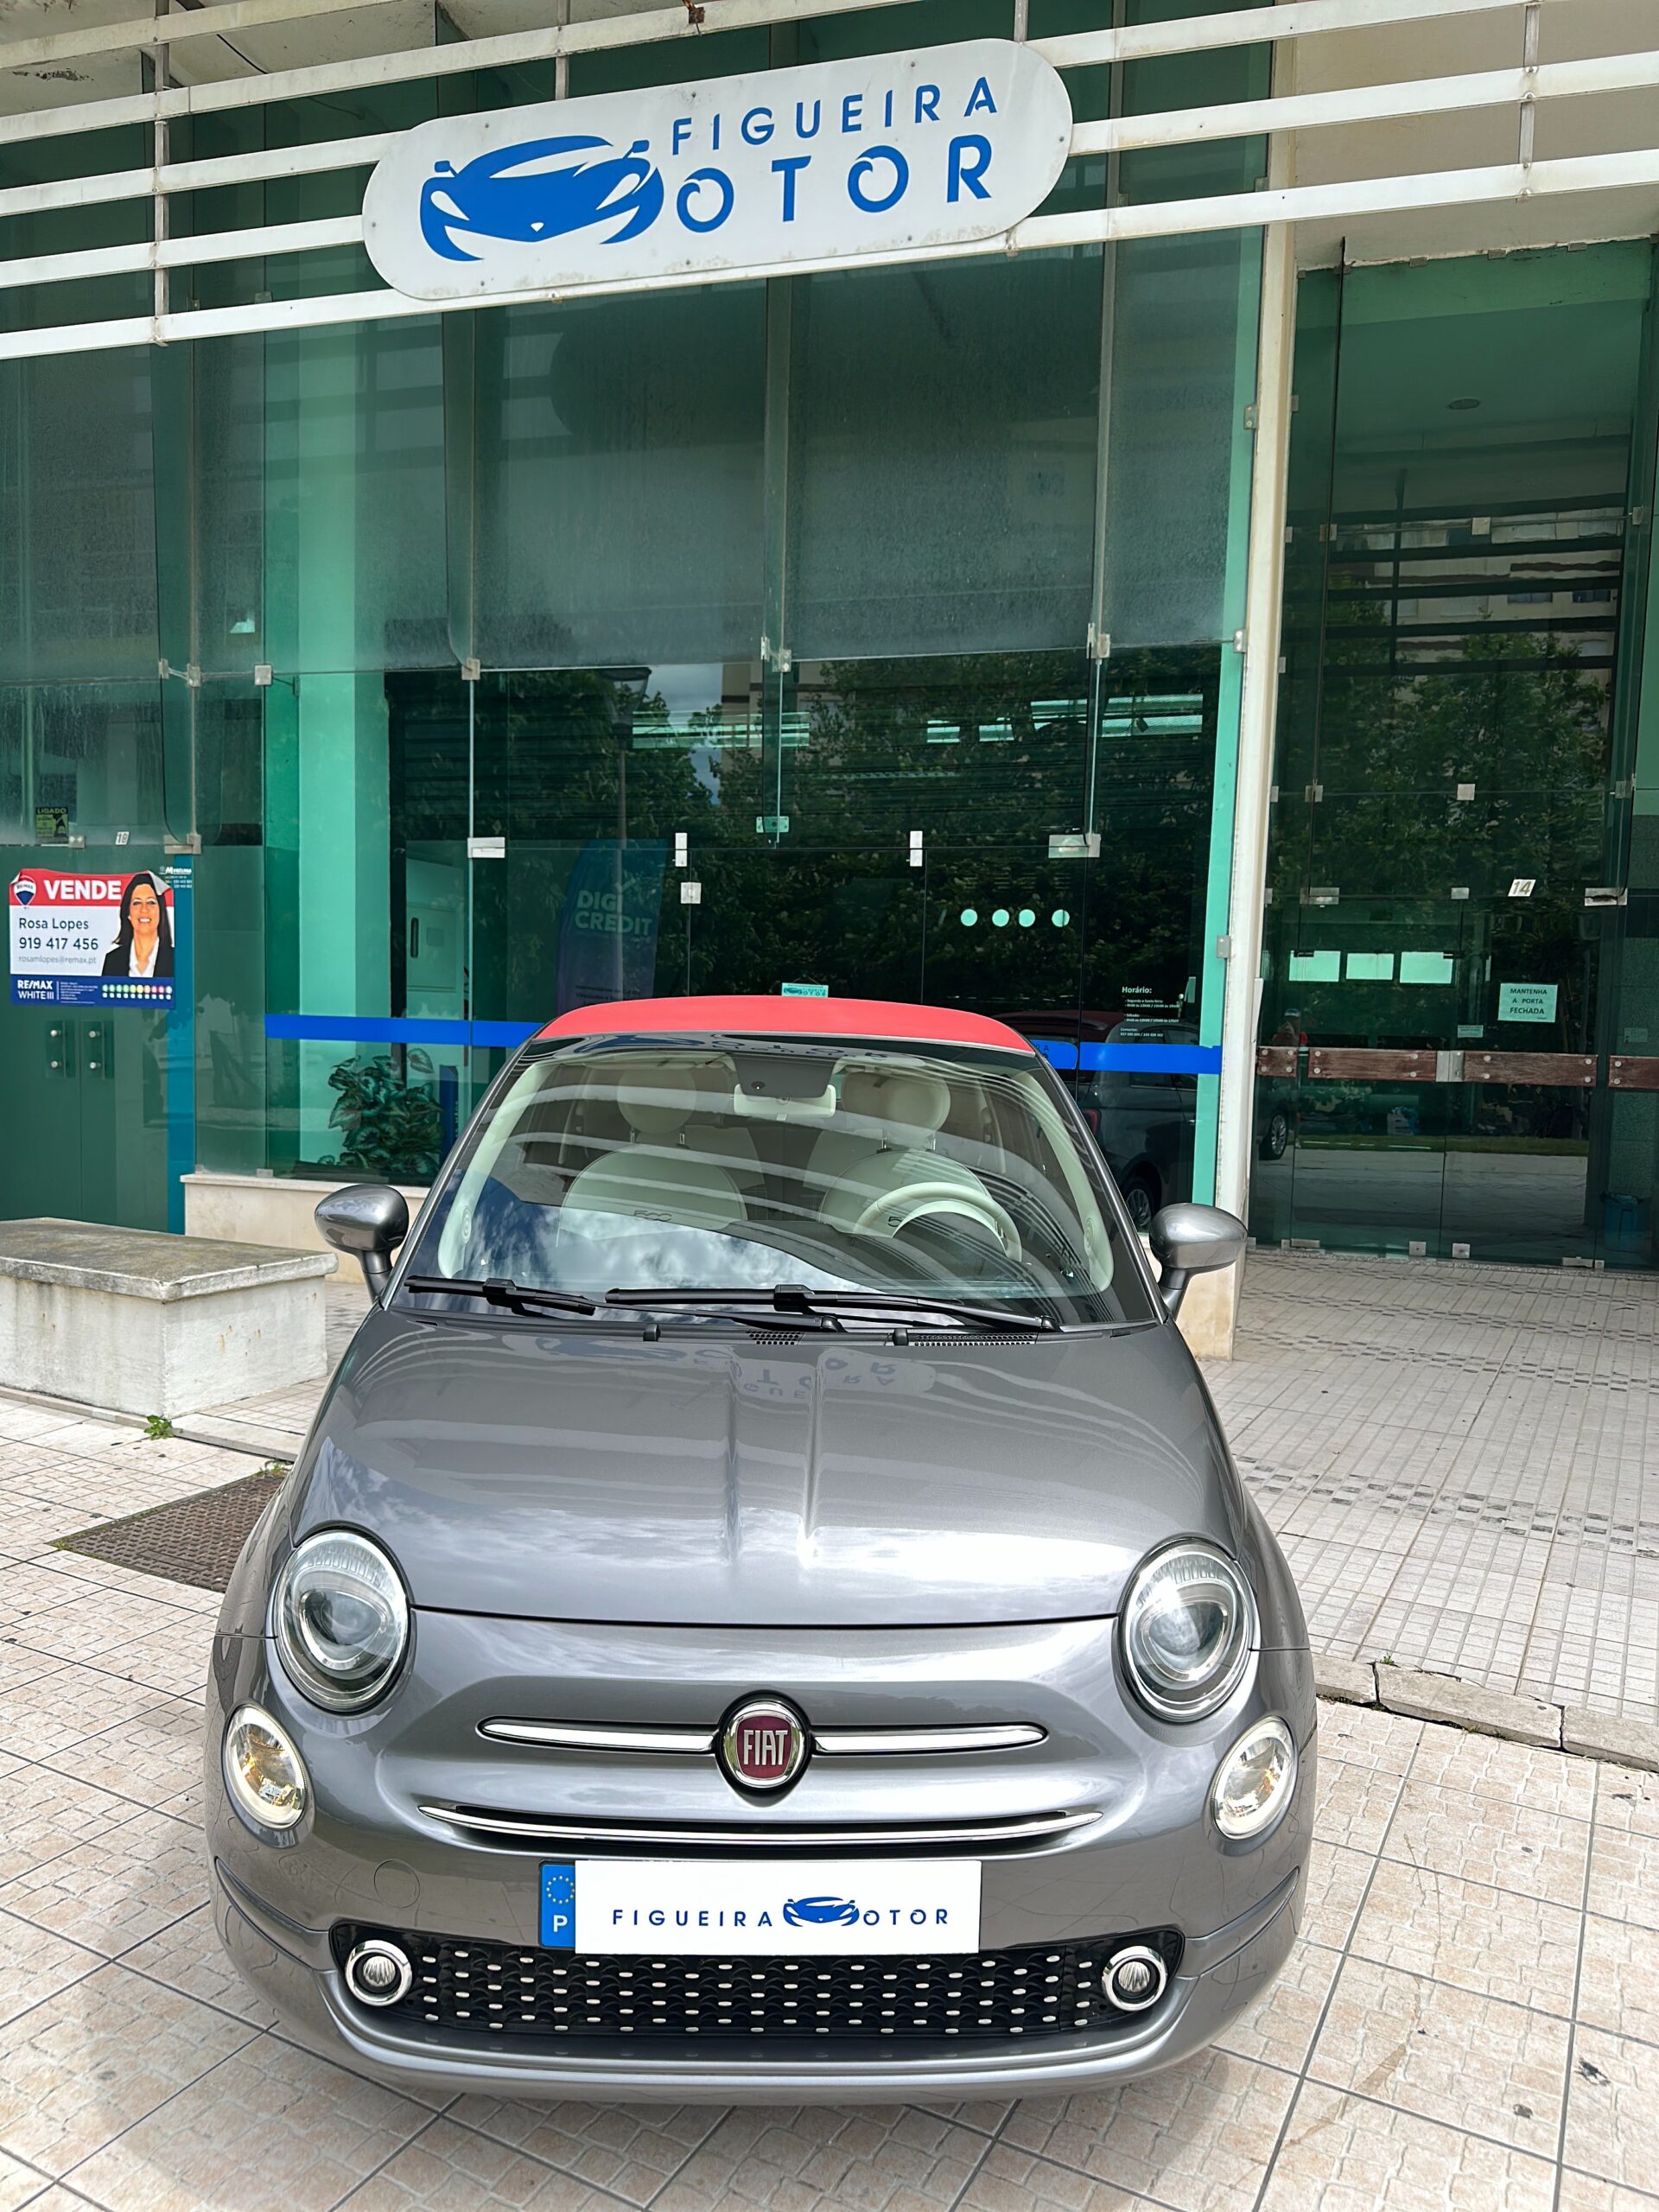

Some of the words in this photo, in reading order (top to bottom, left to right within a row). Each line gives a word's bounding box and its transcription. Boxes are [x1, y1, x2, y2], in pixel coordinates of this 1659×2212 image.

[672, 77, 997, 156] FIGUEIRA
[43, 880, 122, 900] VENDE
[1512, 880, 1532, 895] 14
[19, 918, 48, 930] Rosa
[53, 918, 89, 931] Lopes
[575, 911, 652, 936] CREDIT
[19, 938, 41, 950] 919
[46, 938, 68, 950] 417
[73, 938, 99, 950] 456
[17, 979, 54, 989] RE/MAX
[18, 990, 46, 1000] WHITE
[743, 1729, 788, 1765] FIAT
[553, 1915, 569, 1933] P
[613, 1909, 772, 1928] FIGUEIRA
